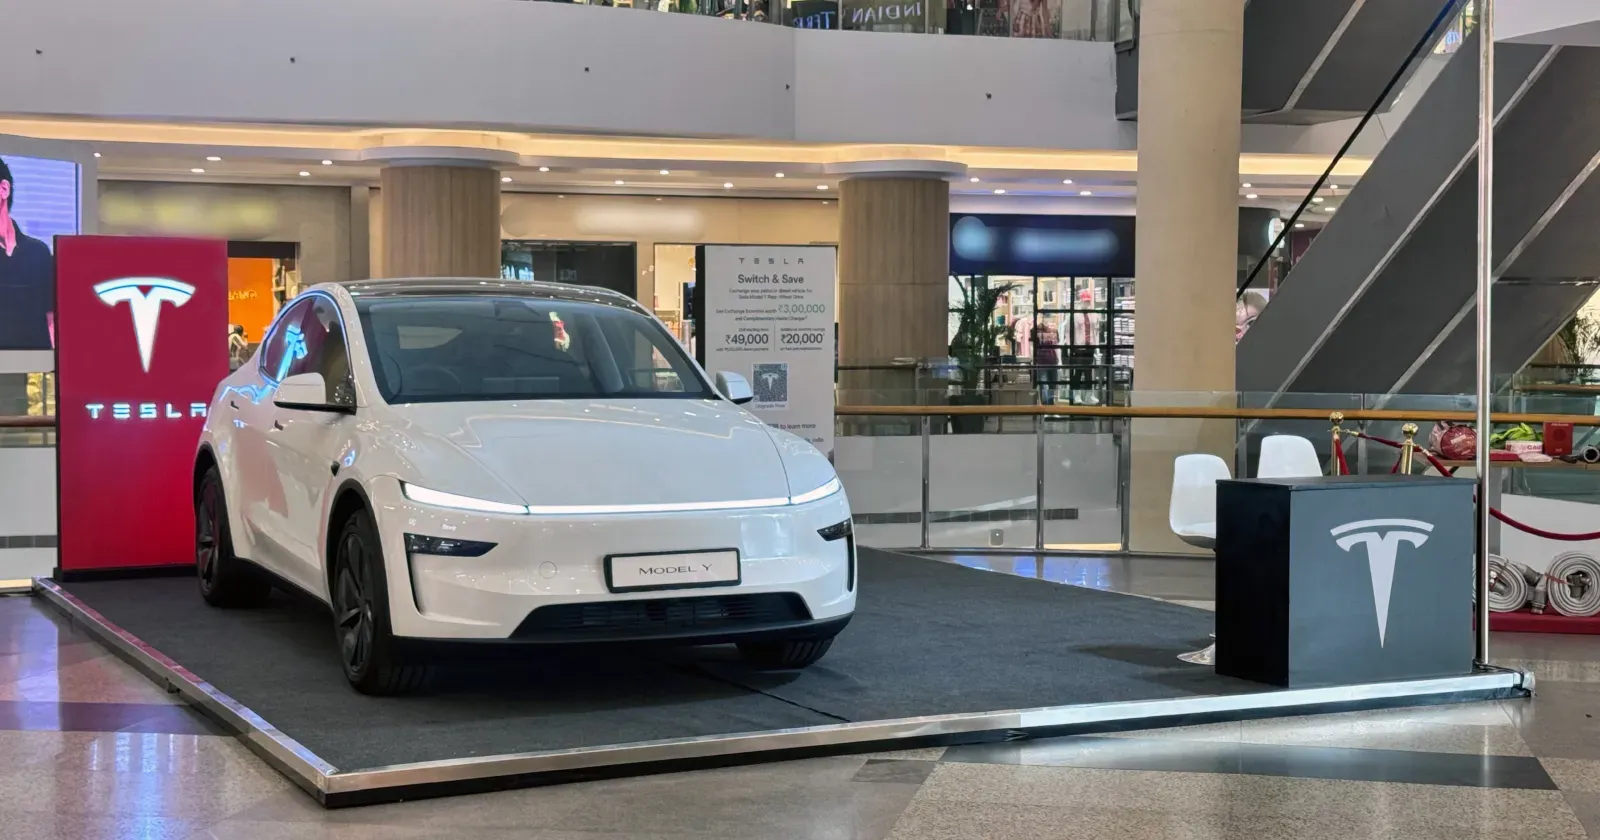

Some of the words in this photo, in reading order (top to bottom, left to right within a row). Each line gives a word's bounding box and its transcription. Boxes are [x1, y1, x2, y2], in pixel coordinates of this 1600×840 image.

[738, 257, 804, 265] TESLA
[738, 274, 770, 284] Switch
[772, 275, 780, 284] &
[782, 274, 804, 284] Save
[778, 303, 826, 315] ₹3,00,000
[725, 333, 769, 346] ₹49,000
[85, 403, 208, 420] TESLA
[639, 565, 698, 575] MODEL
[702, 563, 713, 572] Y
